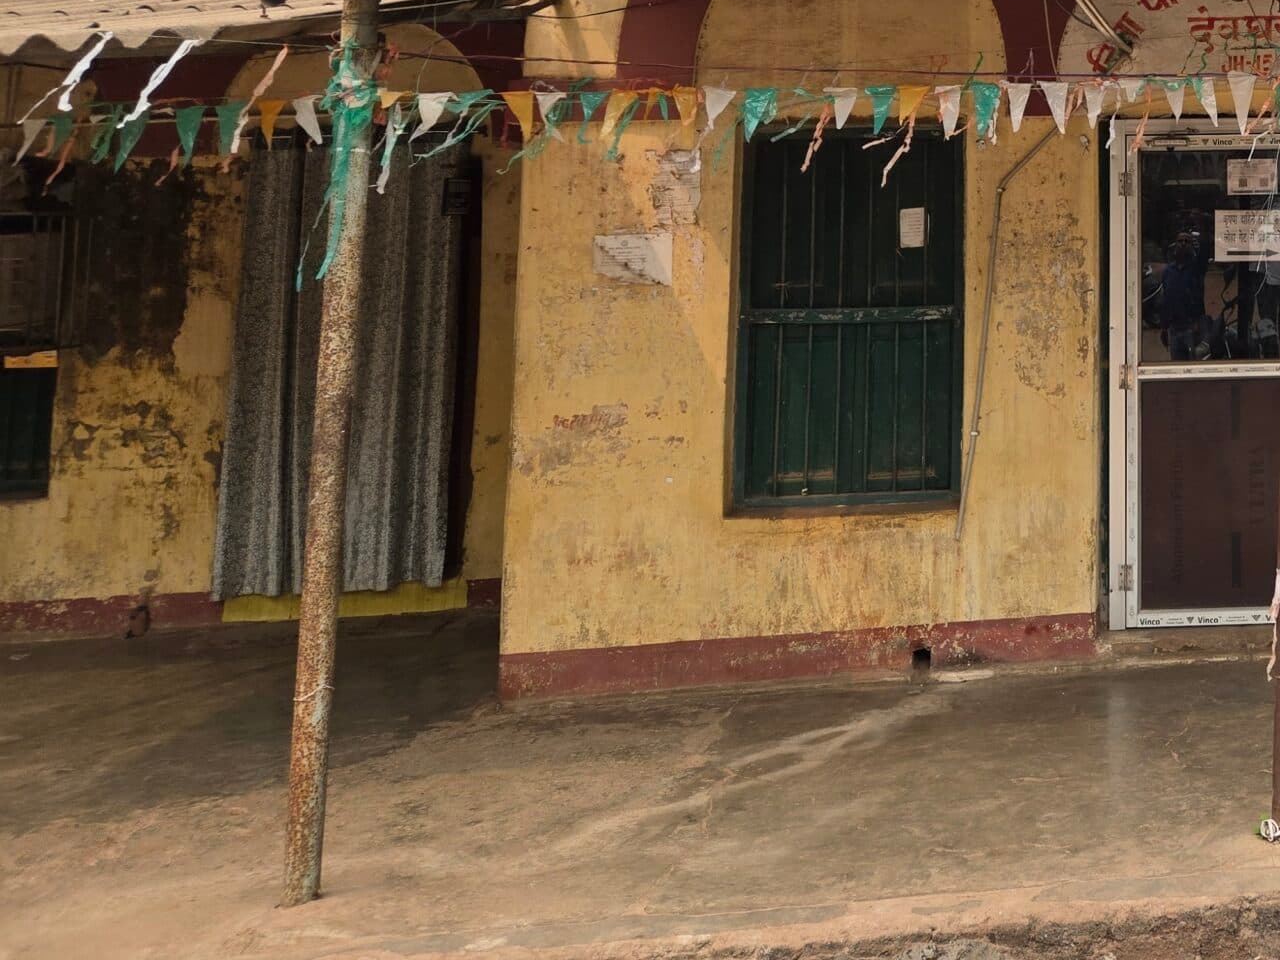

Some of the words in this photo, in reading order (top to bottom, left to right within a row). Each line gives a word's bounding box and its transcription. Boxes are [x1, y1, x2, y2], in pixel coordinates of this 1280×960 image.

[1212, 138, 1233, 146] Vinco
[1139, 617, 1161, 626] Vinco
[1197, 615, 1219, 624] Vinco
